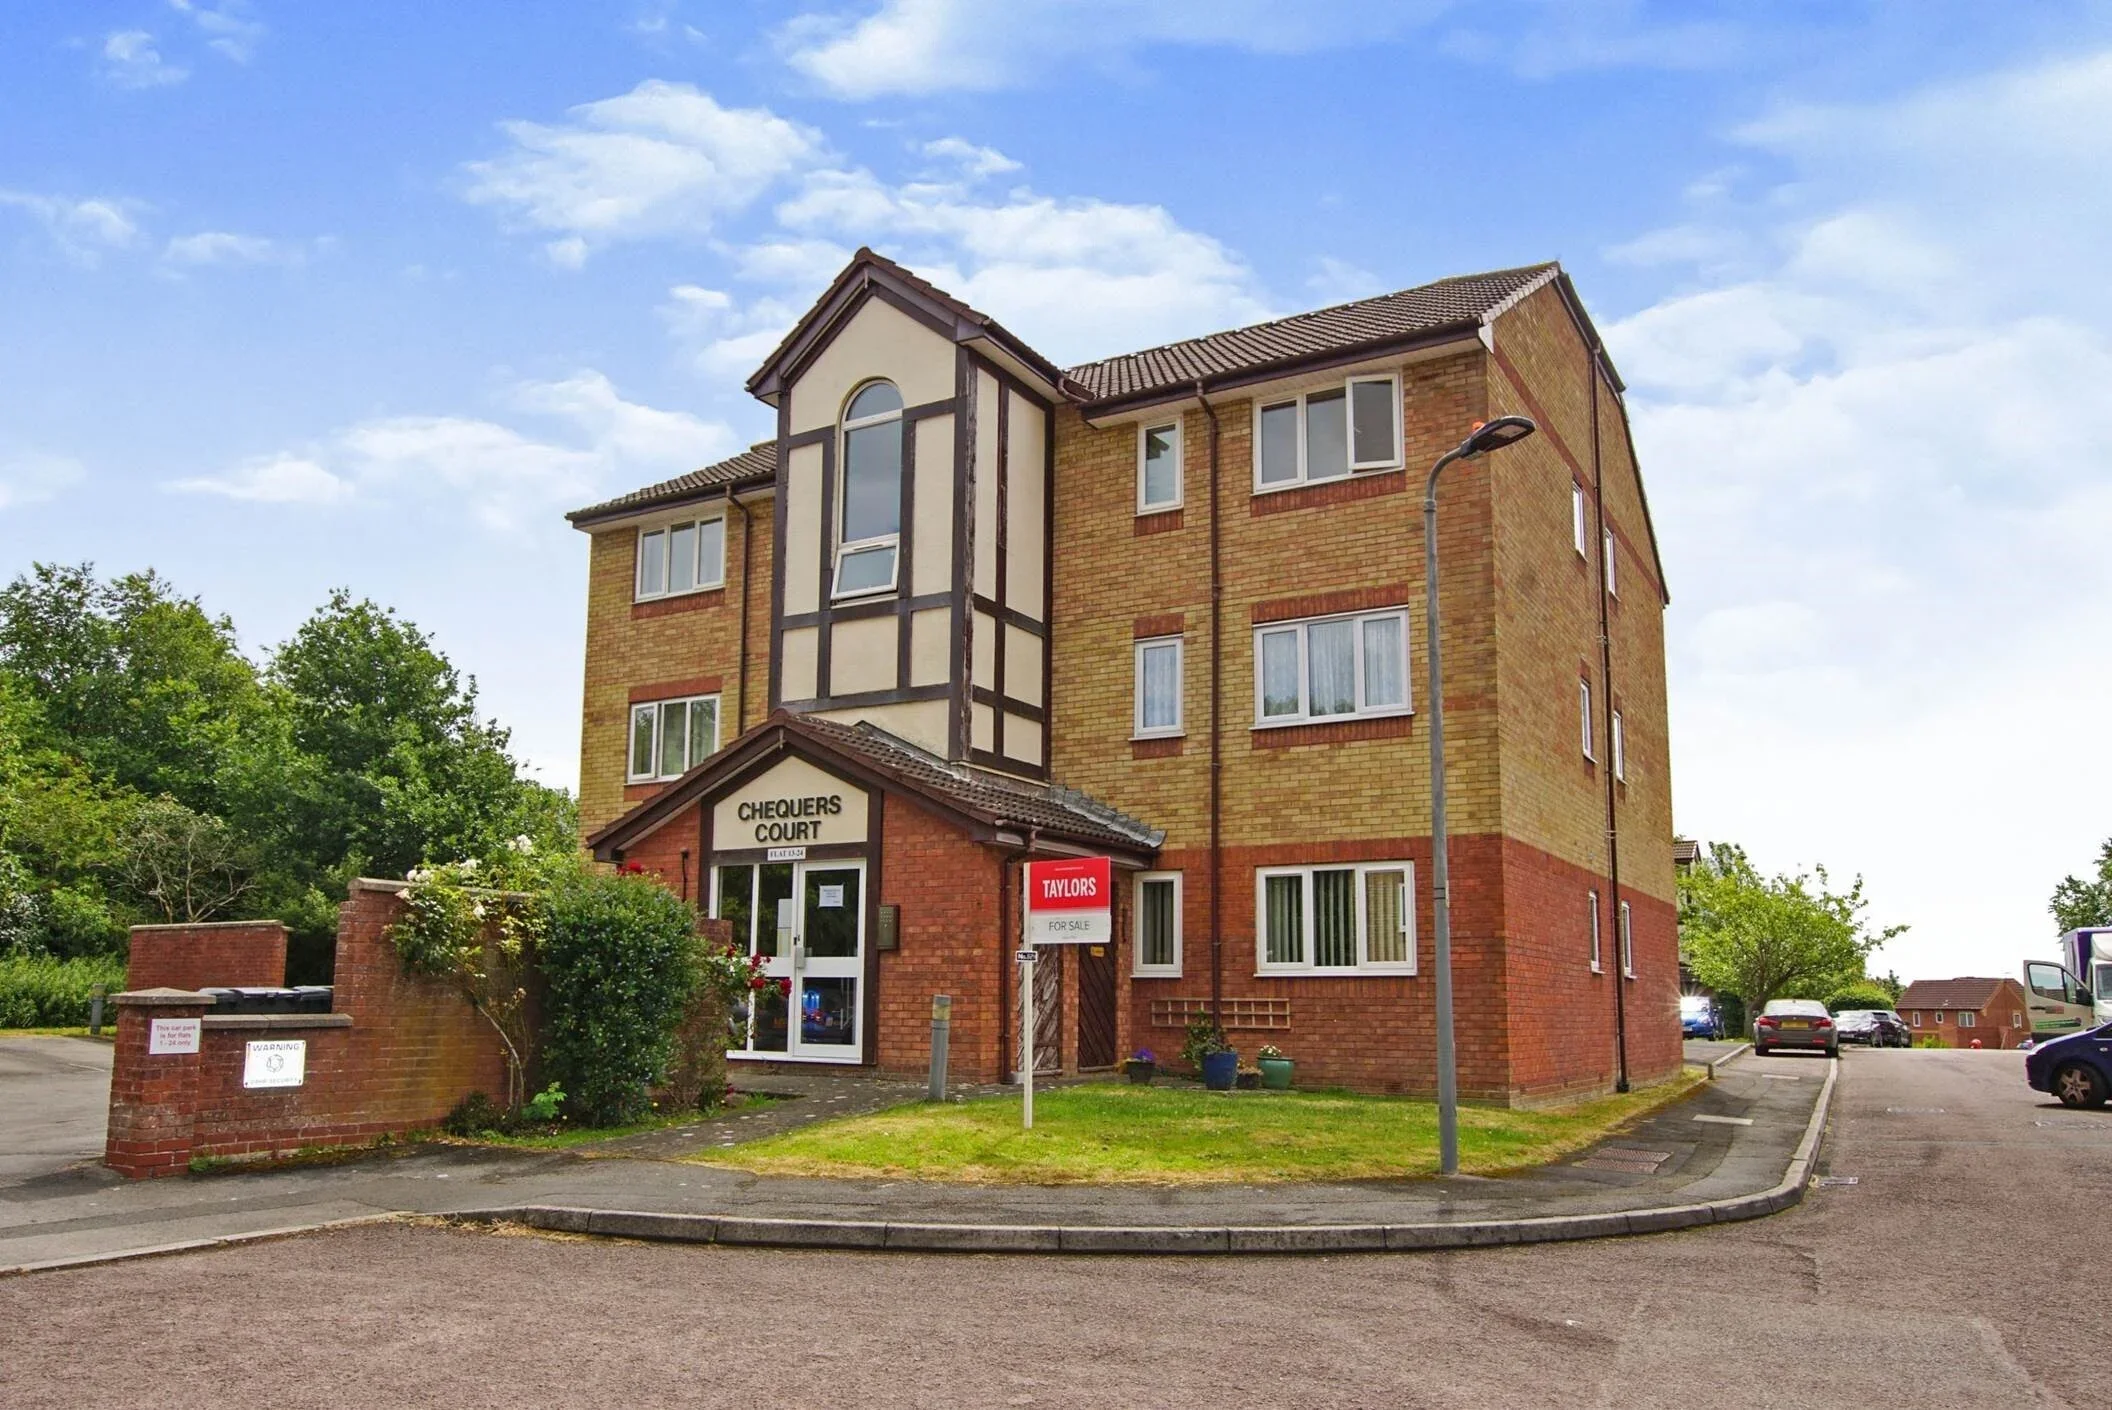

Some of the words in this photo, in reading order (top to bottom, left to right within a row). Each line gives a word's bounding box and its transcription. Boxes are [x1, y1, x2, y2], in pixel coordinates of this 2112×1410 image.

[737, 794, 842, 821] CHEQUERS
[754, 820, 821, 843] COURT
[1042, 877, 1096, 898] TAYLORS
[1048, 921, 1067, 932] FOR
[1069, 920, 1090, 931] SALE
[252, 1043, 300, 1052] WARNING
